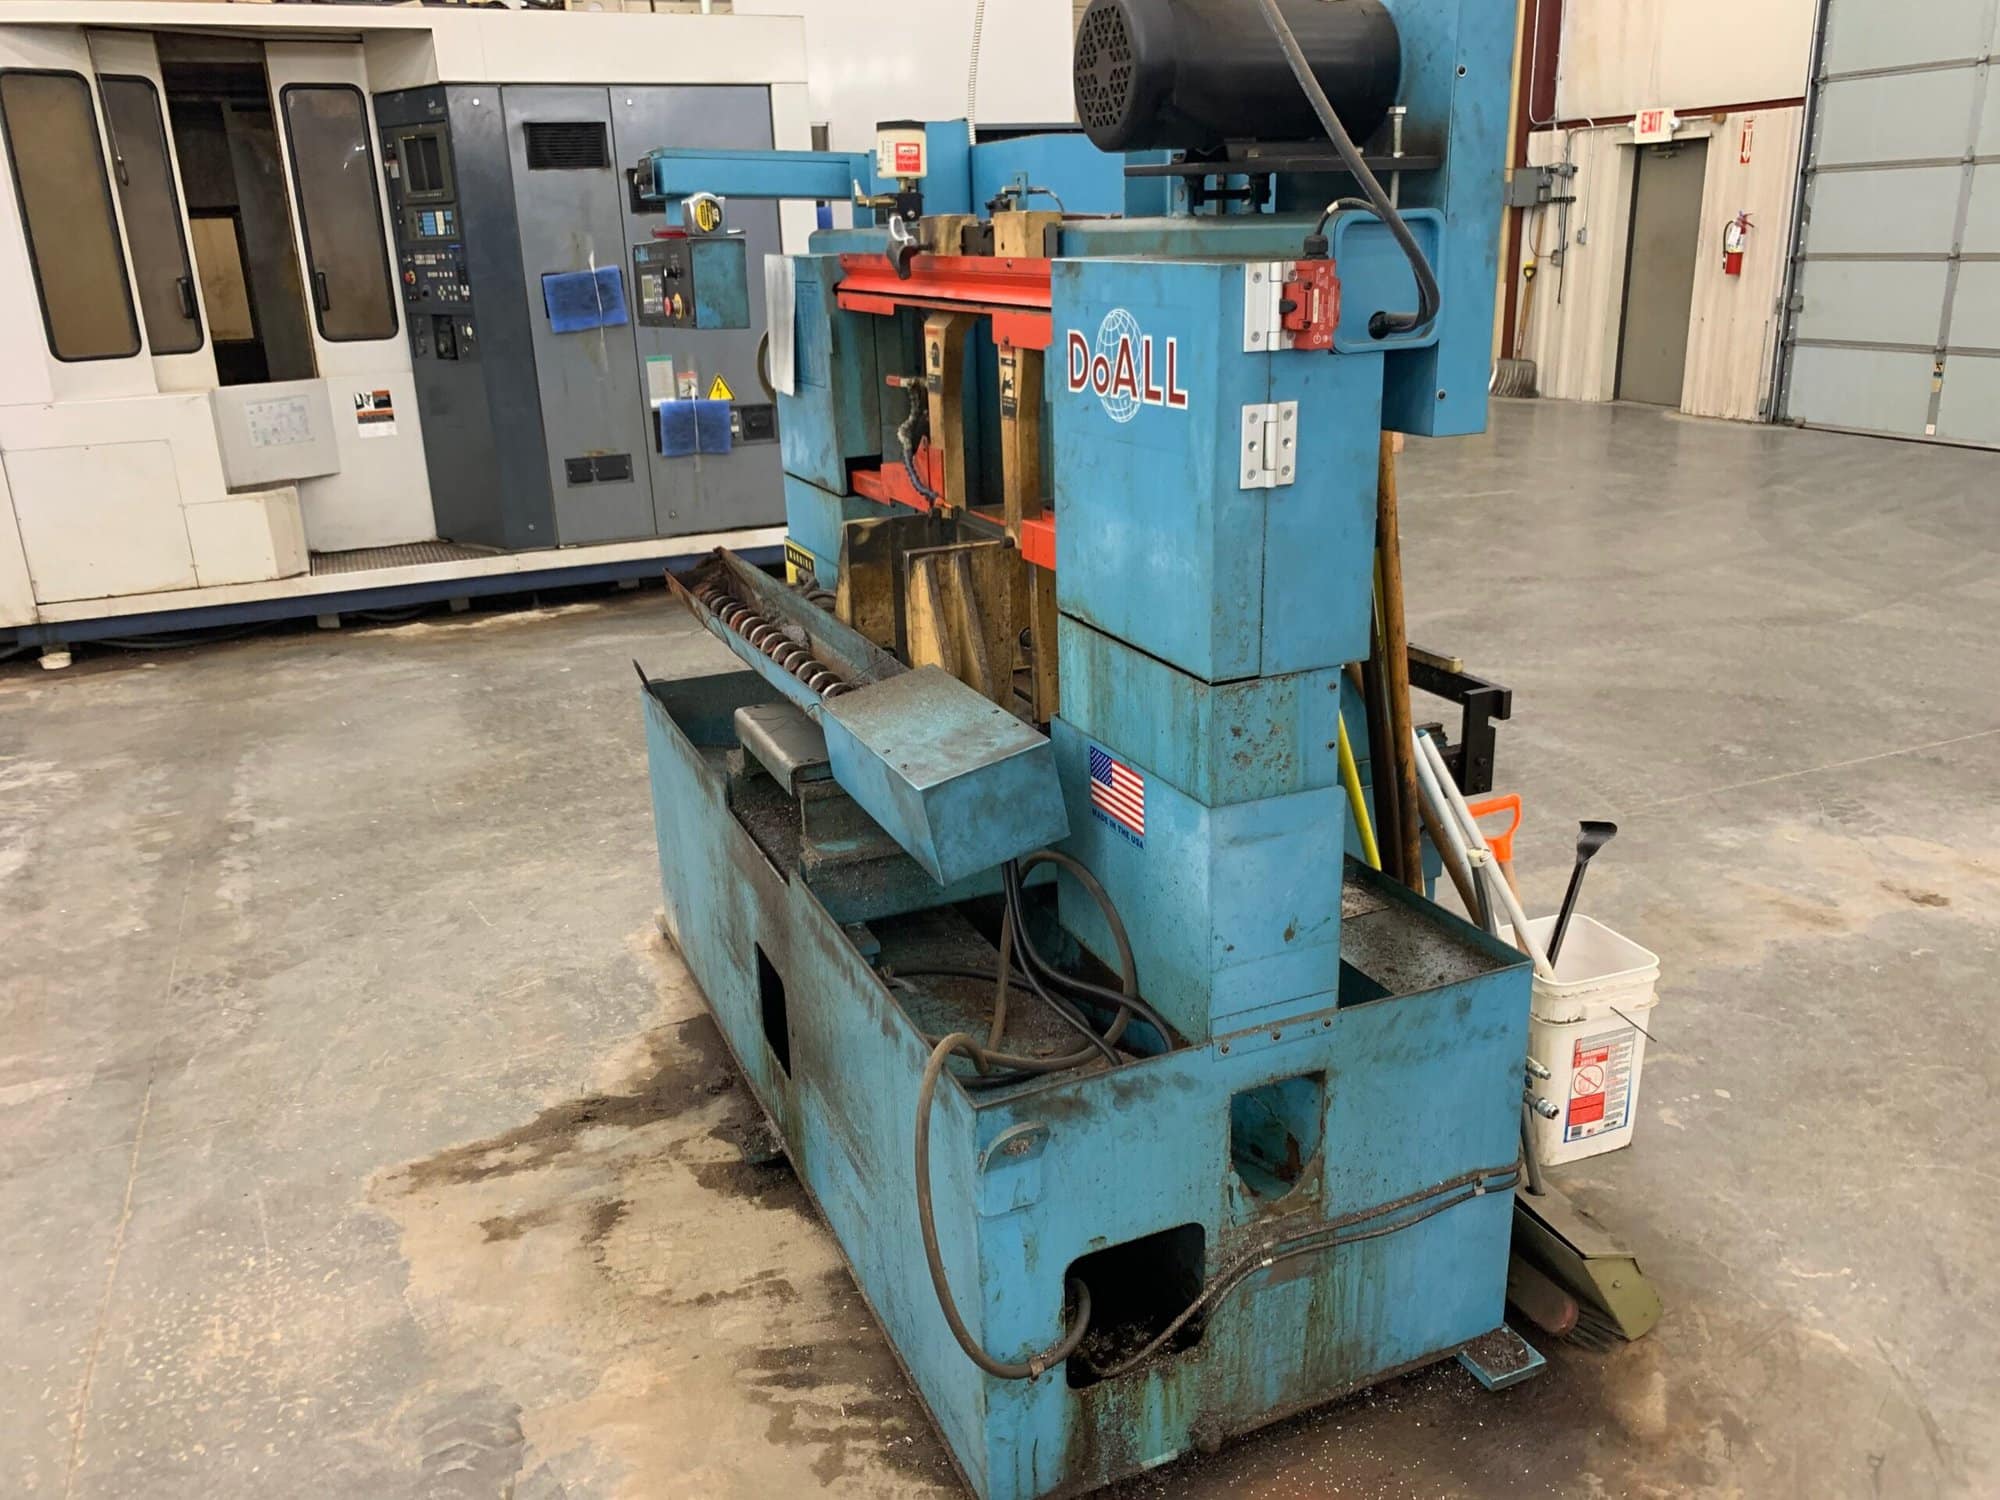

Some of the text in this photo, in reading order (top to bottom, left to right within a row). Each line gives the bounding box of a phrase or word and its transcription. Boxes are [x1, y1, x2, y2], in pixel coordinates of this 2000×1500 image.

[1641, 111, 1664, 134] EXIT
[1068, 329, 1188, 410] DoALL
[1091, 807, 1145, 850] MADE IN THE USA
